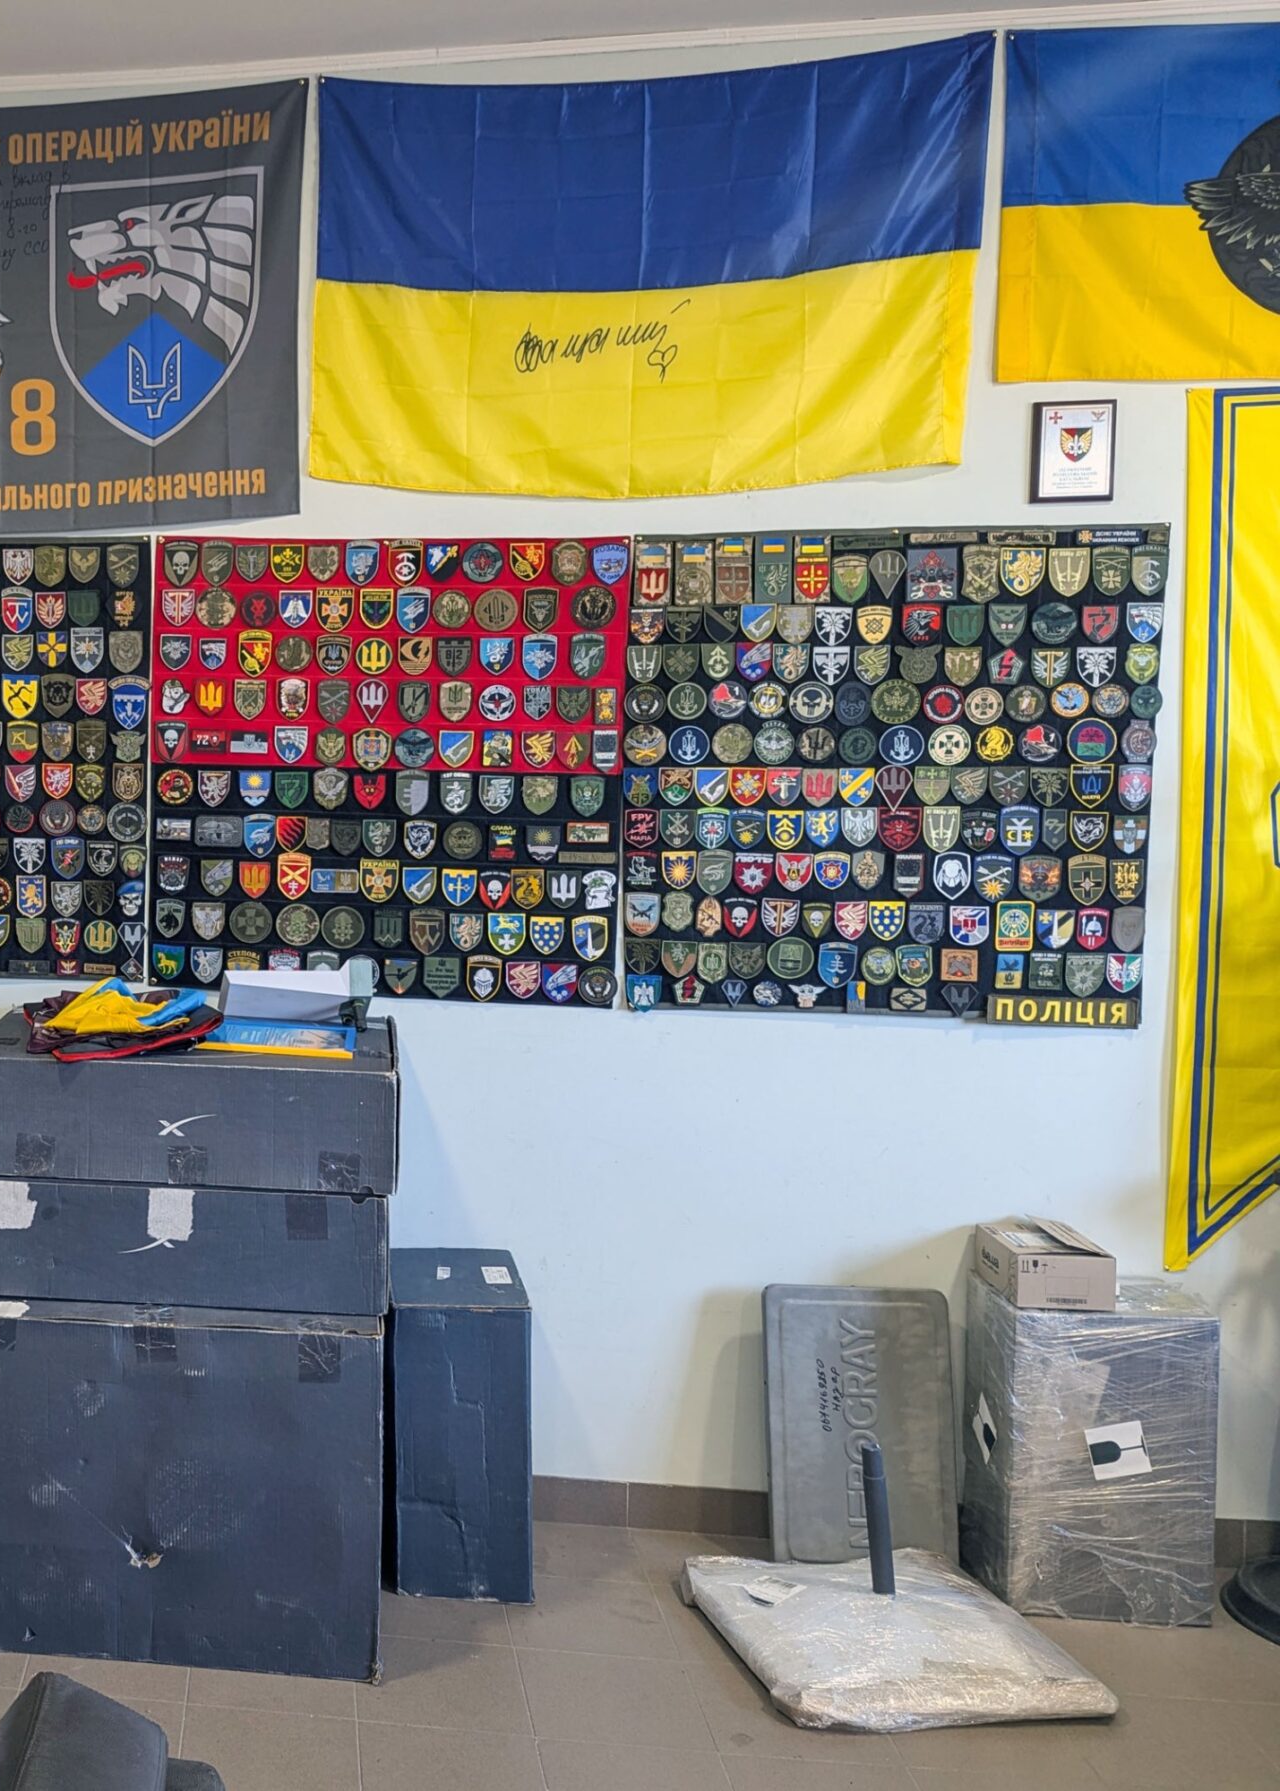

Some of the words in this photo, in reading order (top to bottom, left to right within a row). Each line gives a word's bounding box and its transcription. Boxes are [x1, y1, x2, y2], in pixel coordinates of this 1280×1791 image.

[8, 118, 143, 165] ОПЕРАЦІЙ
[10, 378, 56, 456] 8
[196, 734, 209, 746] 72
[631, 813, 653, 821] FPV
[995, 998, 1128, 1026] ПОЛІЦІЯ
